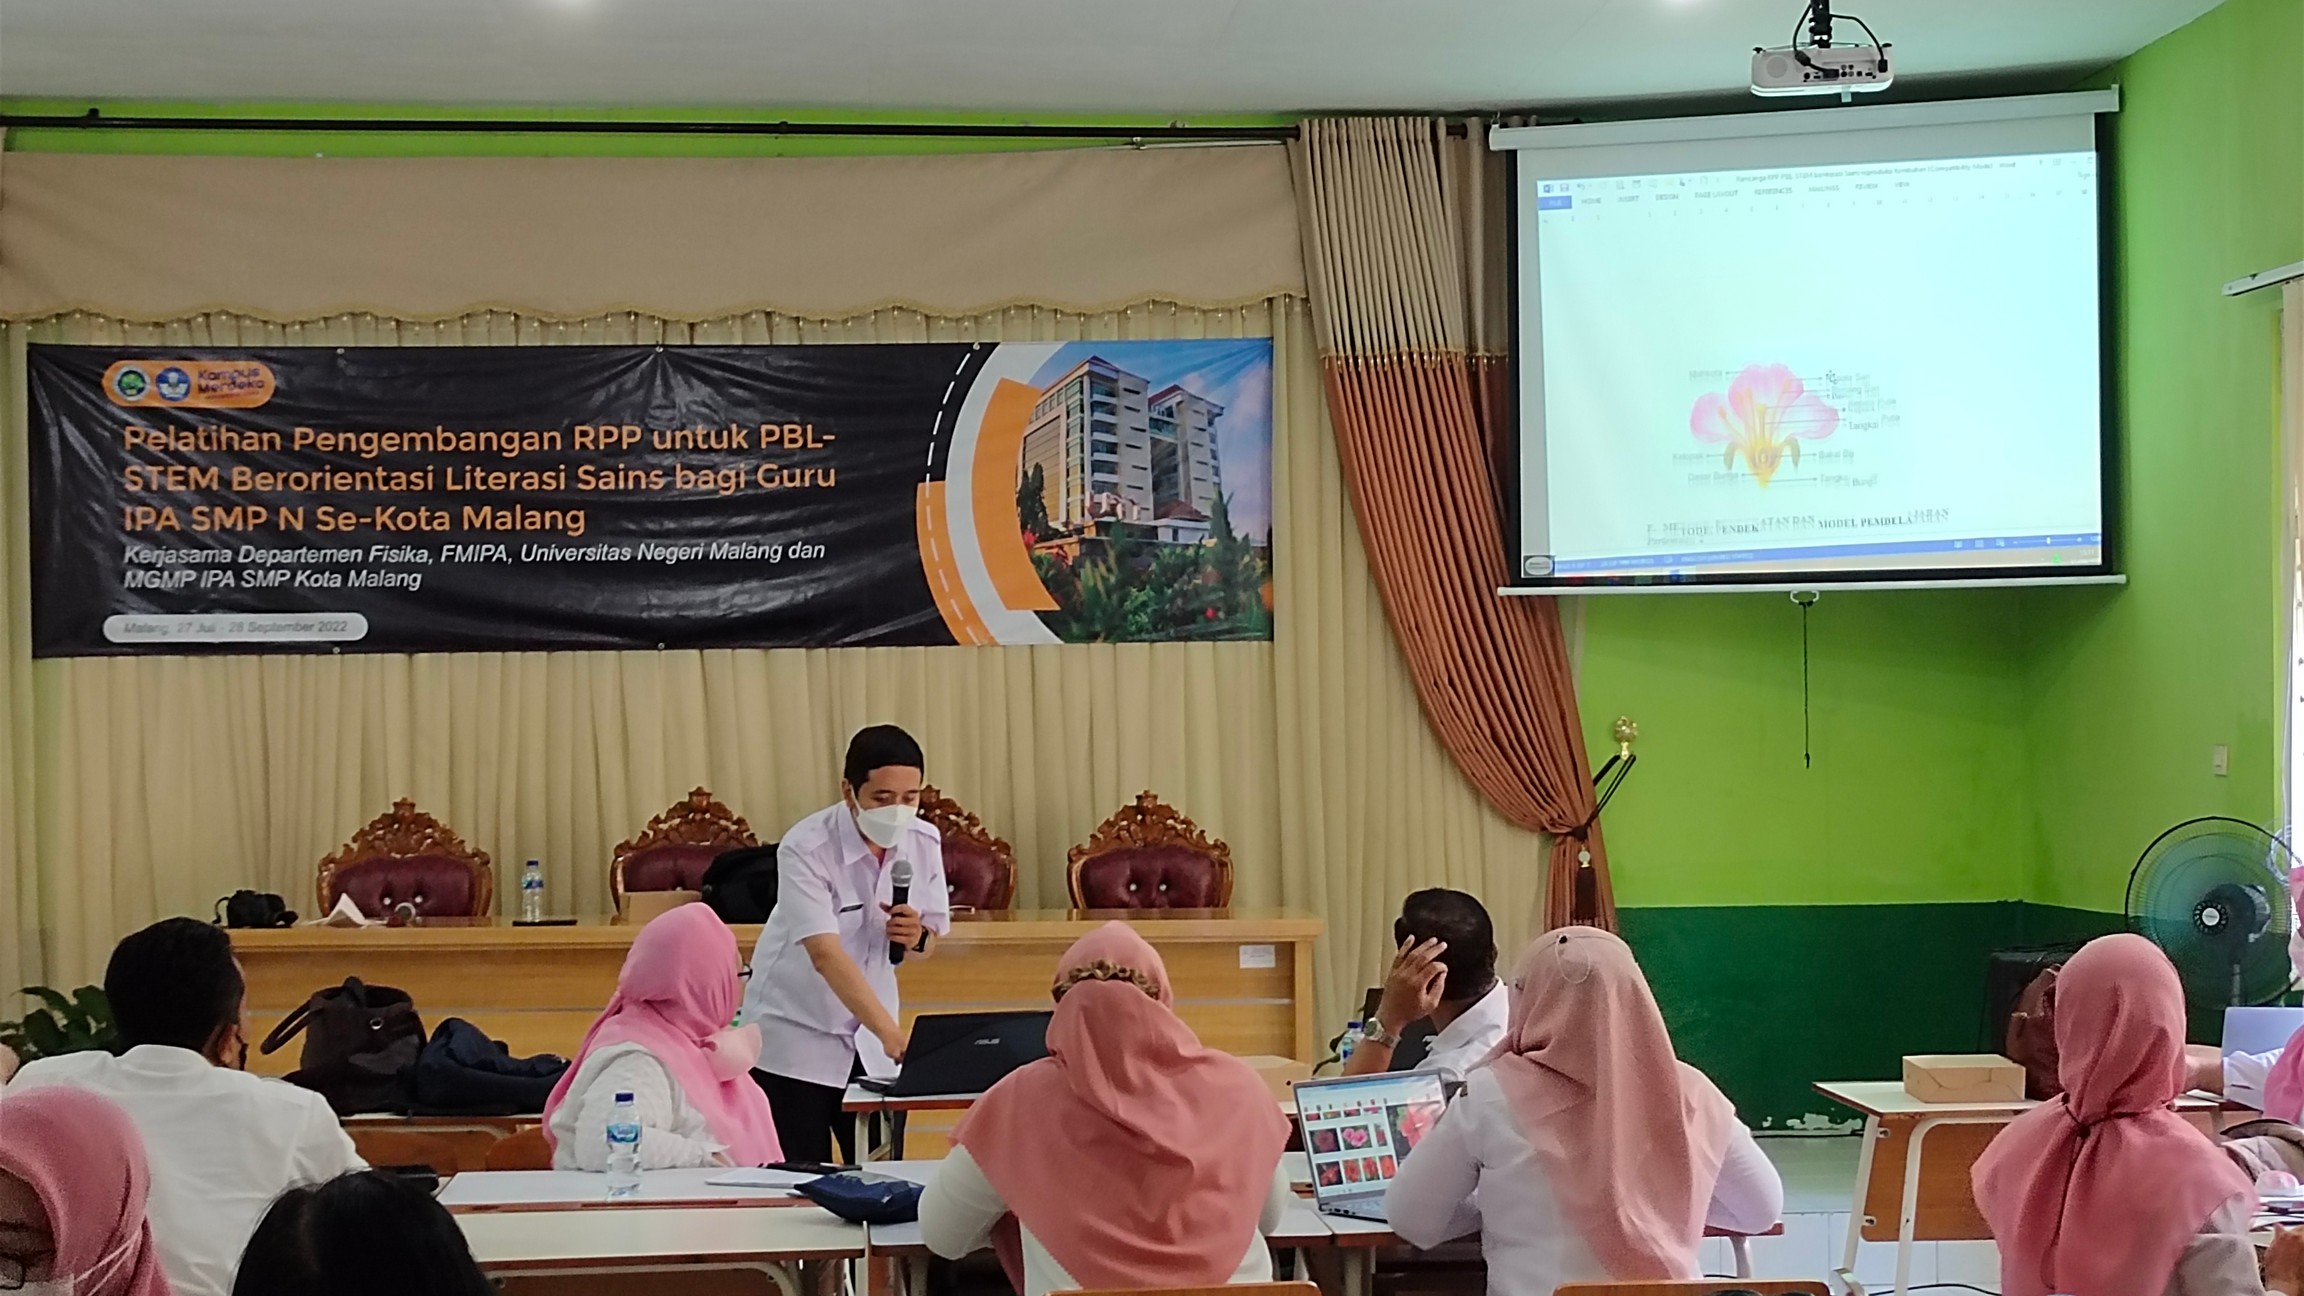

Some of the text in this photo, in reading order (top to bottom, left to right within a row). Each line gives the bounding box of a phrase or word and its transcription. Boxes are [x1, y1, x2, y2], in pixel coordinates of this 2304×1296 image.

[198, 367, 260, 383] Kampus
[198, 380, 265, 394] Merdeka
[124, 424, 835, 459] Pelatihan Pengembangan RPP untuk PBL-
[124, 463, 836, 495] STEM Berorientasi Literasi Sains bagi Guru
[124, 504, 586, 536] IPA SMP N Se-Kota Malang
[1818, 517, 1858, 529] MODEL
[123, 540, 826, 567] Kerjasama Departemen Fisika, FMIPA, Universitas Negeri Malang dan
[123, 568, 422, 591] MGMP IPA SMP Kota Malang
[177, 621, 193, 633] 27
[247, 619, 314, 635] September
[318, 619, 348, 632] 2022
